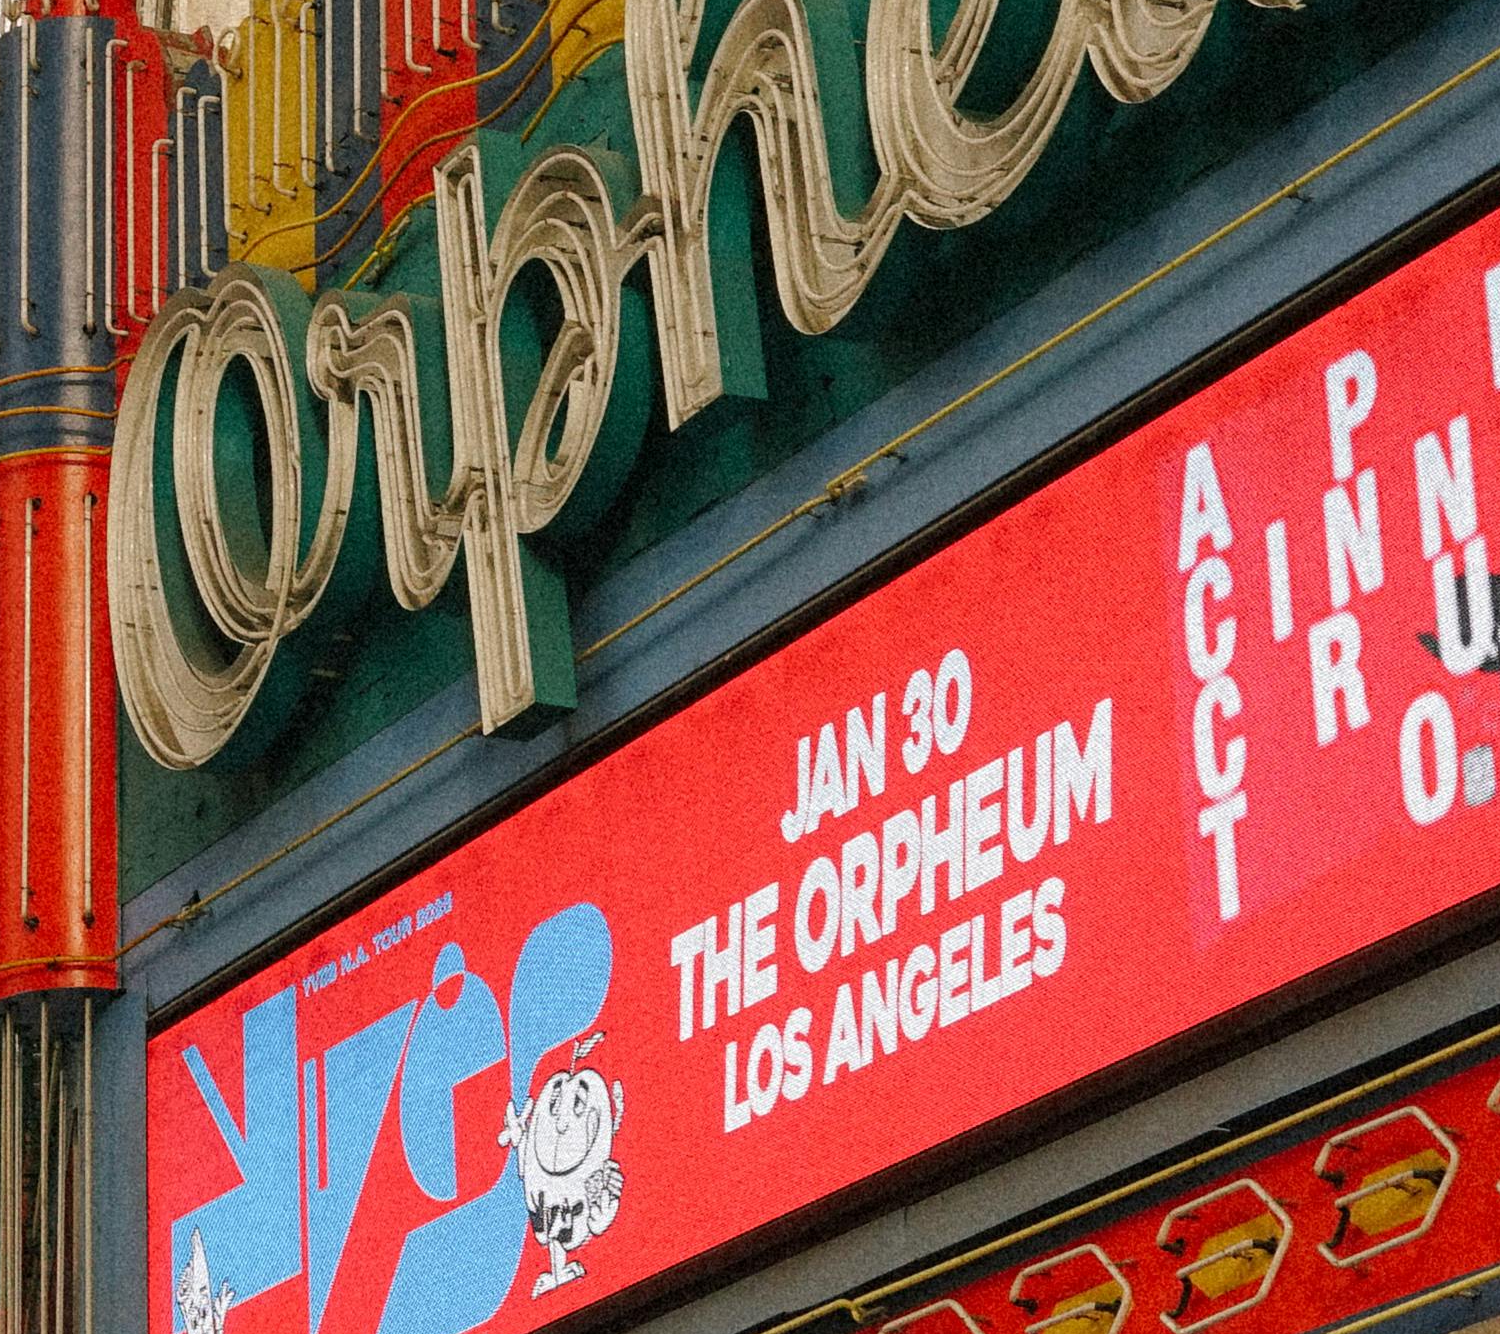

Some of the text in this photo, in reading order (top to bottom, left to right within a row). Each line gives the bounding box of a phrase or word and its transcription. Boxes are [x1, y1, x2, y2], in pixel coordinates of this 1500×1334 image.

[780, 648, 973, 844] JAN 30
[371, 915, 412, 955] TOUR
[670, 698, 1113, 1042] THE ORPHEUM
[723, 877, 1067, 1134] LOS ANGELES
